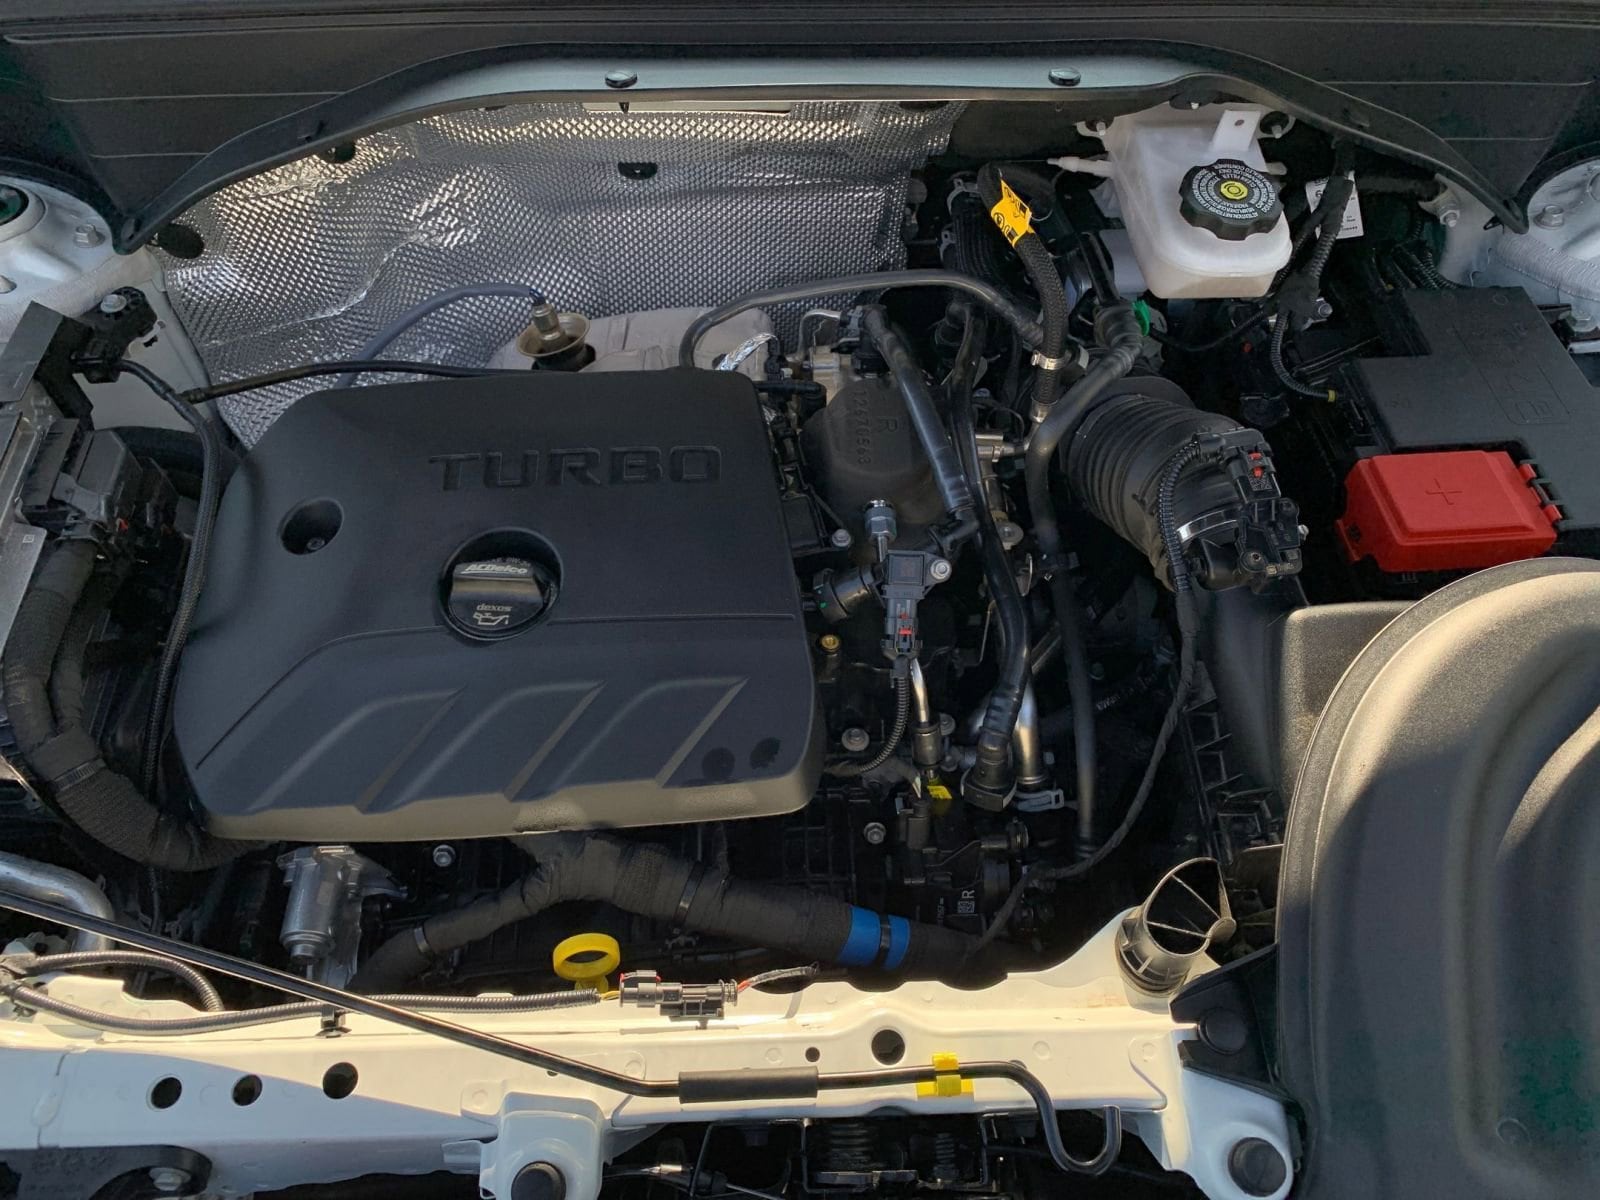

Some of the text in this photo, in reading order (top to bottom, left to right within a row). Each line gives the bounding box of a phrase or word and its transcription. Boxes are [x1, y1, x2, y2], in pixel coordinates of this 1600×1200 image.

[429, 446, 722, 491] TURBO
[465, 564, 528, 574] ACDelco
[476, 603, 512, 612] dexos
[961, 889, 975, 899] R
